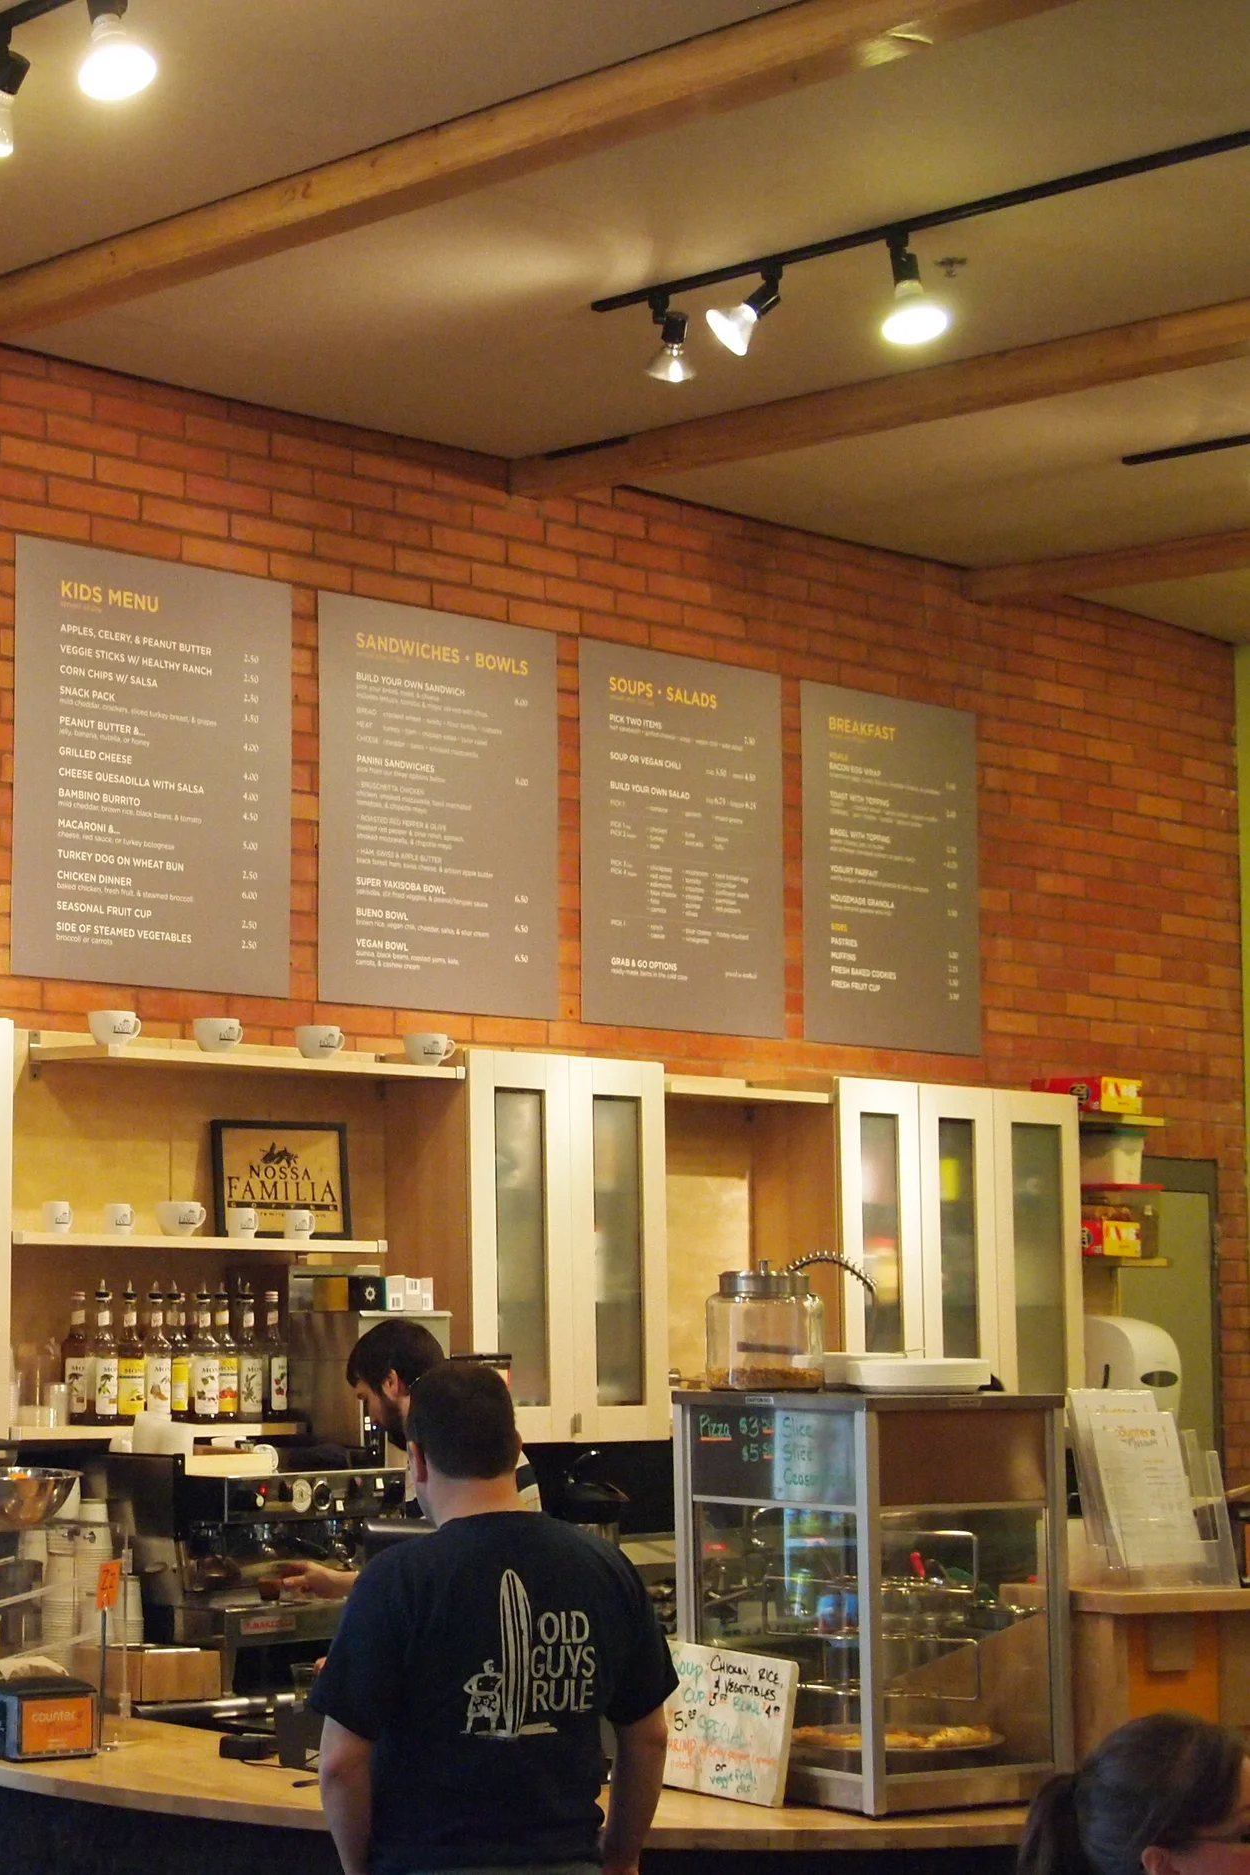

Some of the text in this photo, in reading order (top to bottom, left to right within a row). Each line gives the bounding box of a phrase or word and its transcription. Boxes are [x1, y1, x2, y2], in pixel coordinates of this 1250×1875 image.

[60, 579, 102, 603] KIDS
[108, 588, 159, 613] MENU
[60, 623, 212, 656] APPLES, CELERY, & PEANUT BUTTER
[59, 644, 212, 676] VEGGIE STICKS W/ HEALTHY RANCH
[355, 631, 460, 664] SANDWICHES
[475, 652, 528, 676] BOWLS
[59, 664, 158, 688] CORN CHIPS W/ SALSA
[355, 671, 465, 696] BUILD YOUR OWN SANDWICH
[59, 685, 115, 702] SNACK PACK
[608, 675, 653, 698] SOUPS
[666, 686, 717, 709] SALADS
[59, 715, 145, 736] PEANUT BUTTER &...
[609, 713, 662, 730] PICK TWO ITEMS
[828, 715, 896, 741] BREAKFAST
[58, 745, 132, 765] GRILLED CHEESE
[356, 754, 435, 773] PANINI SANDWICHES
[609, 751, 681, 770] SOUP OR VEGAN CHILI
[58, 766, 204, 794] CHEESE QUESADILLA WITH SALSA
[609, 780, 690, 800] BUILD YOUR OWN SALAD
[58, 787, 141, 807] BAMBINO BURRITO
[57, 818, 120, 834] MACARONI &...
[57, 848, 184, 872] TURKEY DOG ON WHEAT BUN
[56, 869, 132, 887] CHICKEN DINNER
[356, 876, 446, 895] SUPER YAKISOBA BOWL
[56, 900, 152, 918] SEASONAL FRUIT CUP
[355, 906, 409, 921] BUENO BOWL
[56, 921, 192, 943] SIDE OF STEAMED VEGETABLES
[355, 938, 409, 952] VEGAN BOWL
[610, 956, 630, 967] GRAB
[636, 959, 648, 968] GO
[648, 960, 678, 972] OPTIONS
[249, 1165, 311, 1180] NOSSA
[227, 1176, 337, 1202] FAMILIA
[699, 1414, 731, 1436] Pizza
[537, 1610, 590, 1645] OLD
[531, 1645, 596, 1679] GUYS
[532, 1679, 594, 1713] RULE
[724, 1680, 777, 1700] VEGETABLES
